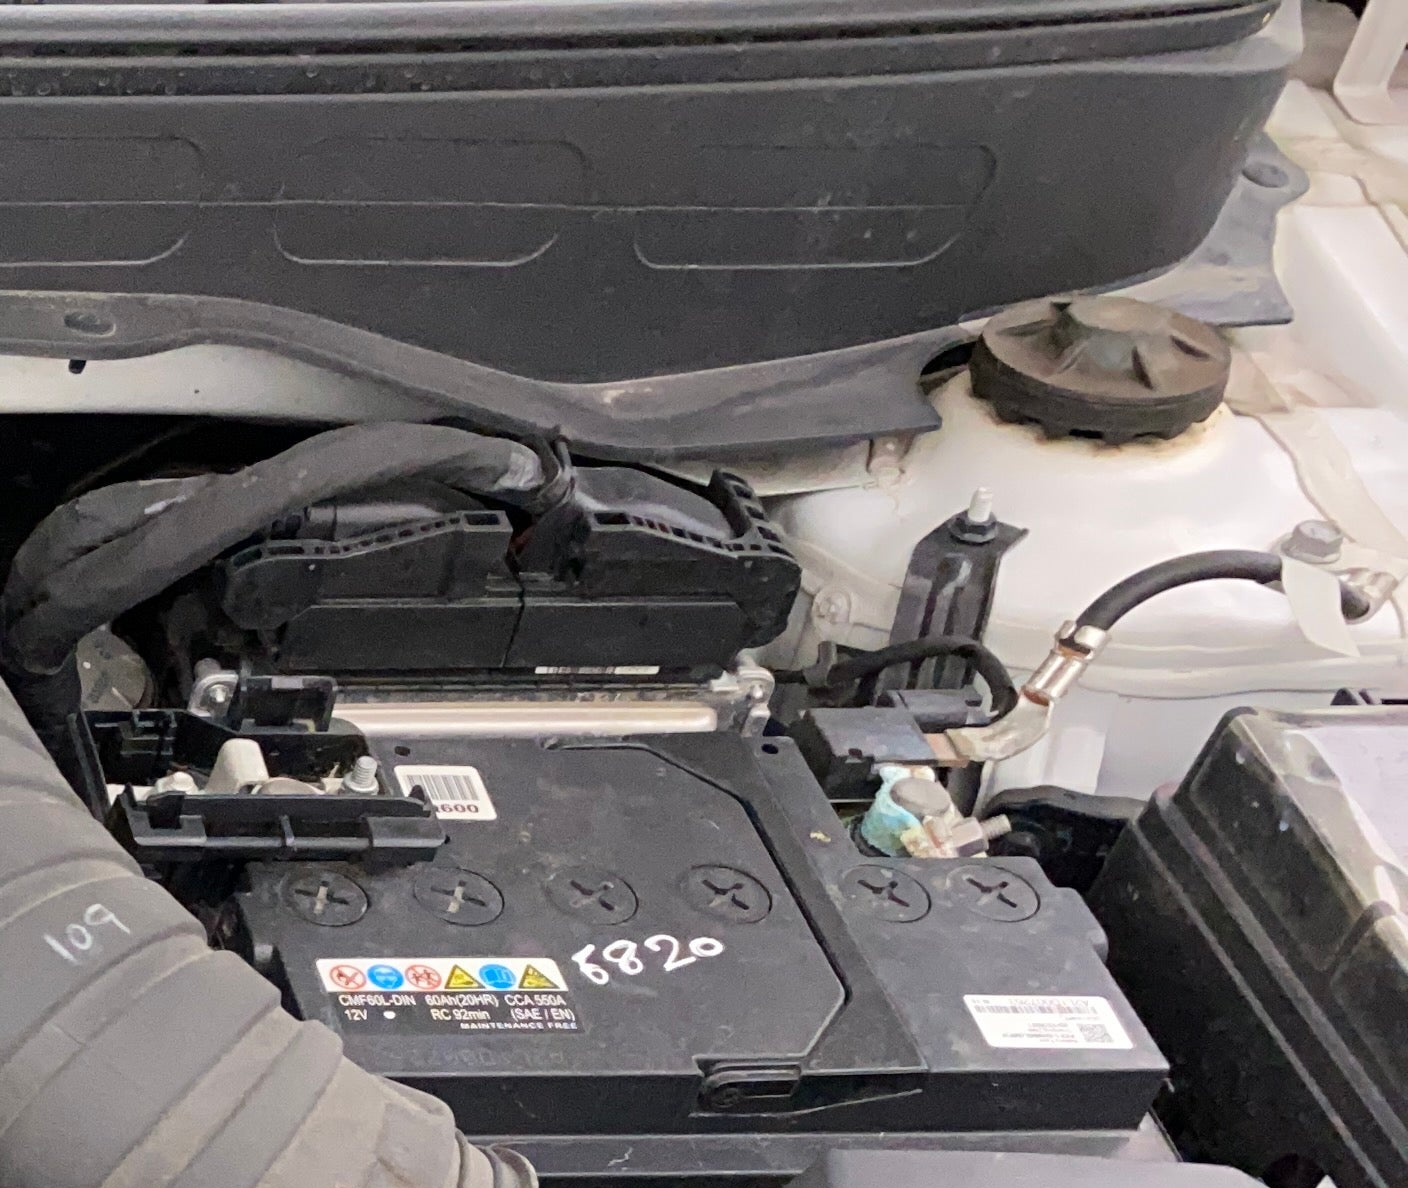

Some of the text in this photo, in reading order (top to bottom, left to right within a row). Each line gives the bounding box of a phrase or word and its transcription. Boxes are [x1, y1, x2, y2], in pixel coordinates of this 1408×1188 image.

[436, 803, 479, 813] 600
[43, 903, 131, 966] 109
[338, 994, 566, 1008] CMF60L-DIN 60Ah(20HR) CCA 550A
[344, 1009, 368, 1021] 12V
[430, 1009, 450, 1020] RC
[453, 1009, 491, 1020] 92min
[460, 1022, 578, 1030] MAINTENANCE FREE
